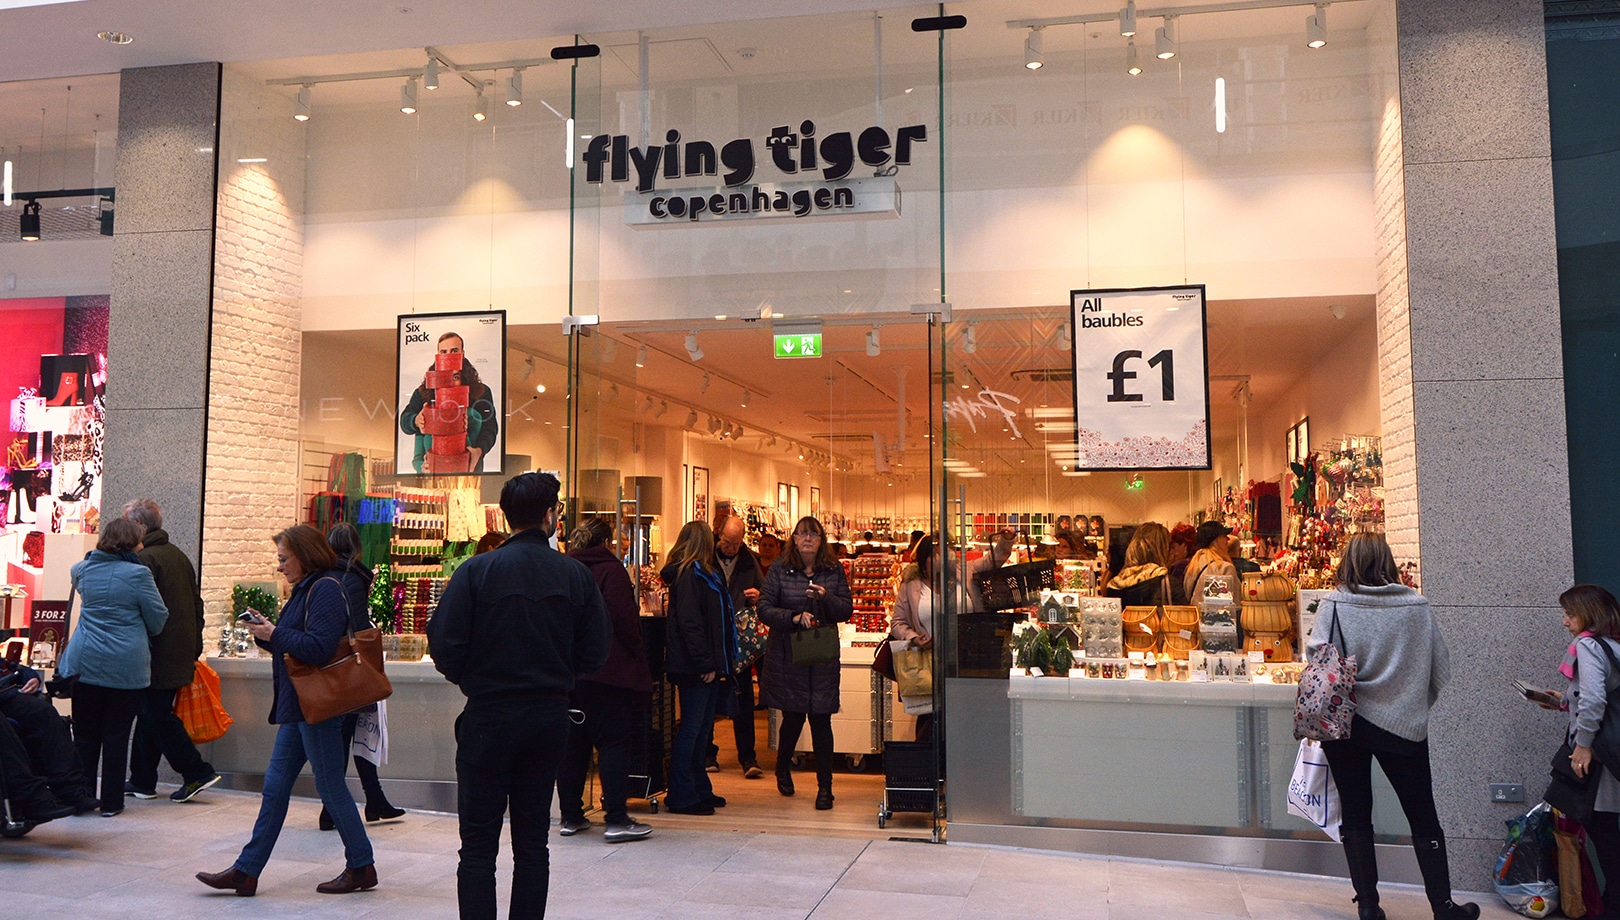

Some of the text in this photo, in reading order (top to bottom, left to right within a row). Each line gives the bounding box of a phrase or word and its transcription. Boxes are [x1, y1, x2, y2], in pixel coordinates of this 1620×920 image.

[583, 119, 928, 193] flying tiger
[649, 186, 855, 221] copenhagen
[1081, 298, 1102, 312] All
[405, 322, 420, 333] Six
[1082, 313, 1144, 328] baubles
[405, 332, 430, 345] pack
[1107, 349, 1175, 402] £1
[34, 610, 66, 619] 3 FOR 2
